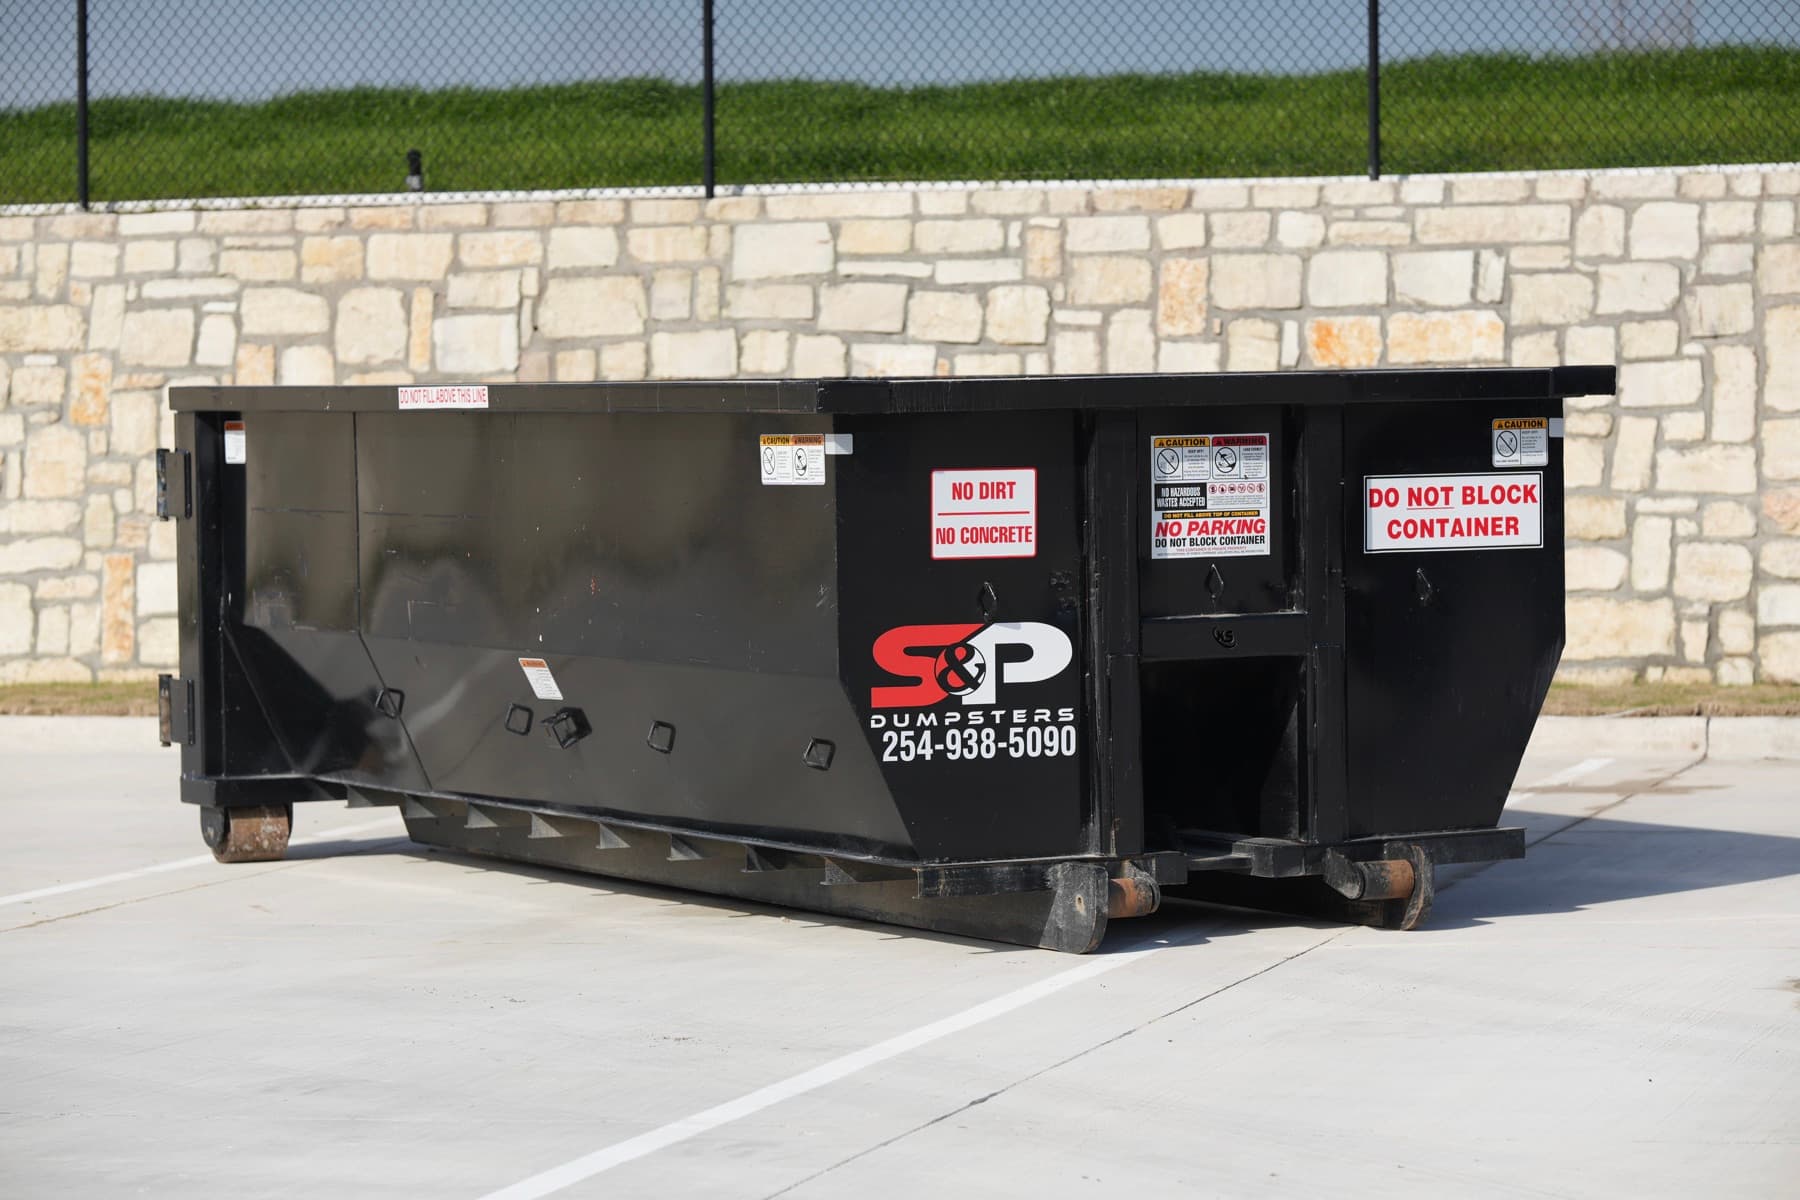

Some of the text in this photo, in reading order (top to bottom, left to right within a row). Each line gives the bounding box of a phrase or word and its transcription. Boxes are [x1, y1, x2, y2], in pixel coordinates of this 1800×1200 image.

[400, 387, 486, 404] DO NOT FILL ABOVE THIS LINE
[1504, 420, 1543, 428] CAUTION
[766, 436, 790, 445] CAUTION
[798, 436, 822, 445] WARNING
[1166, 438, 1206, 447] CAUTION
[1224, 436, 1264, 446] WARNING
[952, 481, 1016, 500] NO DIRT
[1161, 486, 1201, 497] NO HAZARDOUS
[1369, 484, 1538, 508] DO NOT BLOCK
[1157, 497, 1178, 508] WASTES
[1179, 496, 1205, 507] ACCEPTED
[936, 526, 1033, 545] NO CONCRETE
[1155, 518, 1266, 537] NO PARKING
[1387, 516, 1519, 539] CONTAINER
[1155, 535, 1265, 548] DO NOT BLOCK CONTAINER
[871, 622, 1073, 708] S&P
[870, 708, 1075, 728] DUMPSTERS
[882, 725, 1077, 762] 254-938-5090
